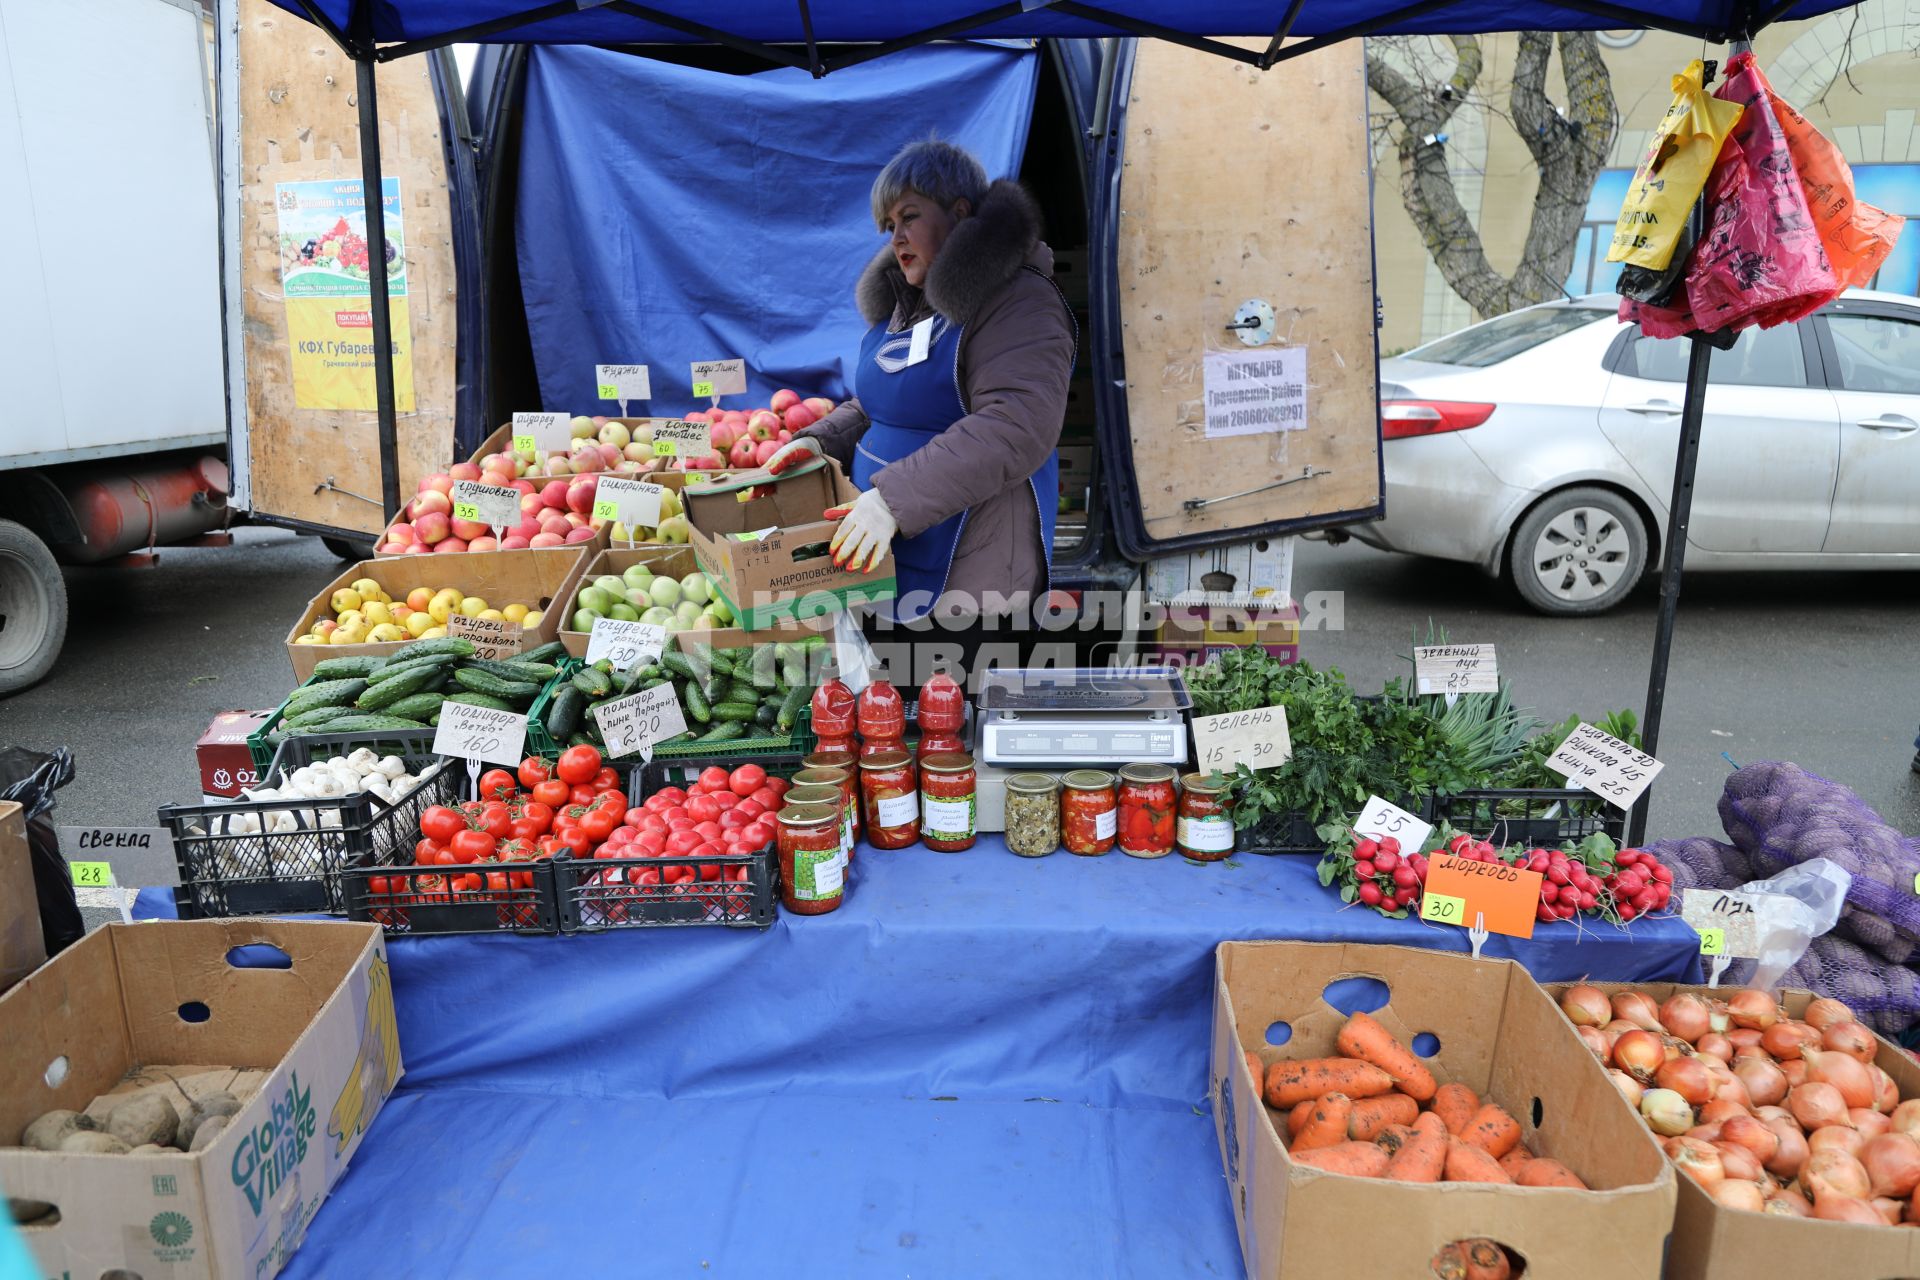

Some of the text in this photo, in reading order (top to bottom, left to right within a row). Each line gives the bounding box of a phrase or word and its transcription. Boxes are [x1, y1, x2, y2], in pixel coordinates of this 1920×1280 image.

[298, 341, 324, 355] КФХ
[360, 360, 376, 368] райо
[1227, 359, 1284, 381] ИП ГУБАРЕВ
[602, 387, 615, 397] 75
[698, 385, 709, 394] 75
[1271, 382, 1303, 402] район
[519, 438, 532, 449] 55
[659, 444, 670, 453] 60
[458, 481, 517, 499] грушовка
[459, 507, 475, 518] 35
[599, 505, 612, 515] 50
[452, 614, 504, 634] огурец
[598, 619, 653, 637] огурец
[607, 646, 636, 662] 130
[1455, 658, 1480, 670] лук
[1448, 672, 1472, 688] 25
[604, 691, 656, 717] помидор
[451, 705, 517, 728] помидор
[1207, 711, 1273, 733] зелень
[623, 715, 661, 747] 220
[463, 735, 501, 754] 160
[1206, 746, 1224, 764] 15
[1254, 742, 1273, 757] 30
[1579, 725, 1655, 767] щавель 30
[1555, 751, 1631, 796] кинза 25
[1620, 765, 1646, 781] 45
[1373, 807, 1411, 833] 55
[79, 829, 152, 849] свекла
[80, 867, 102, 883] 28
[1438, 856, 1519, 883] морковь
[1430, 901, 1455, 917] 30
[232, 1070, 312, 1187] Global
[242, 1107, 317, 1218] Village
